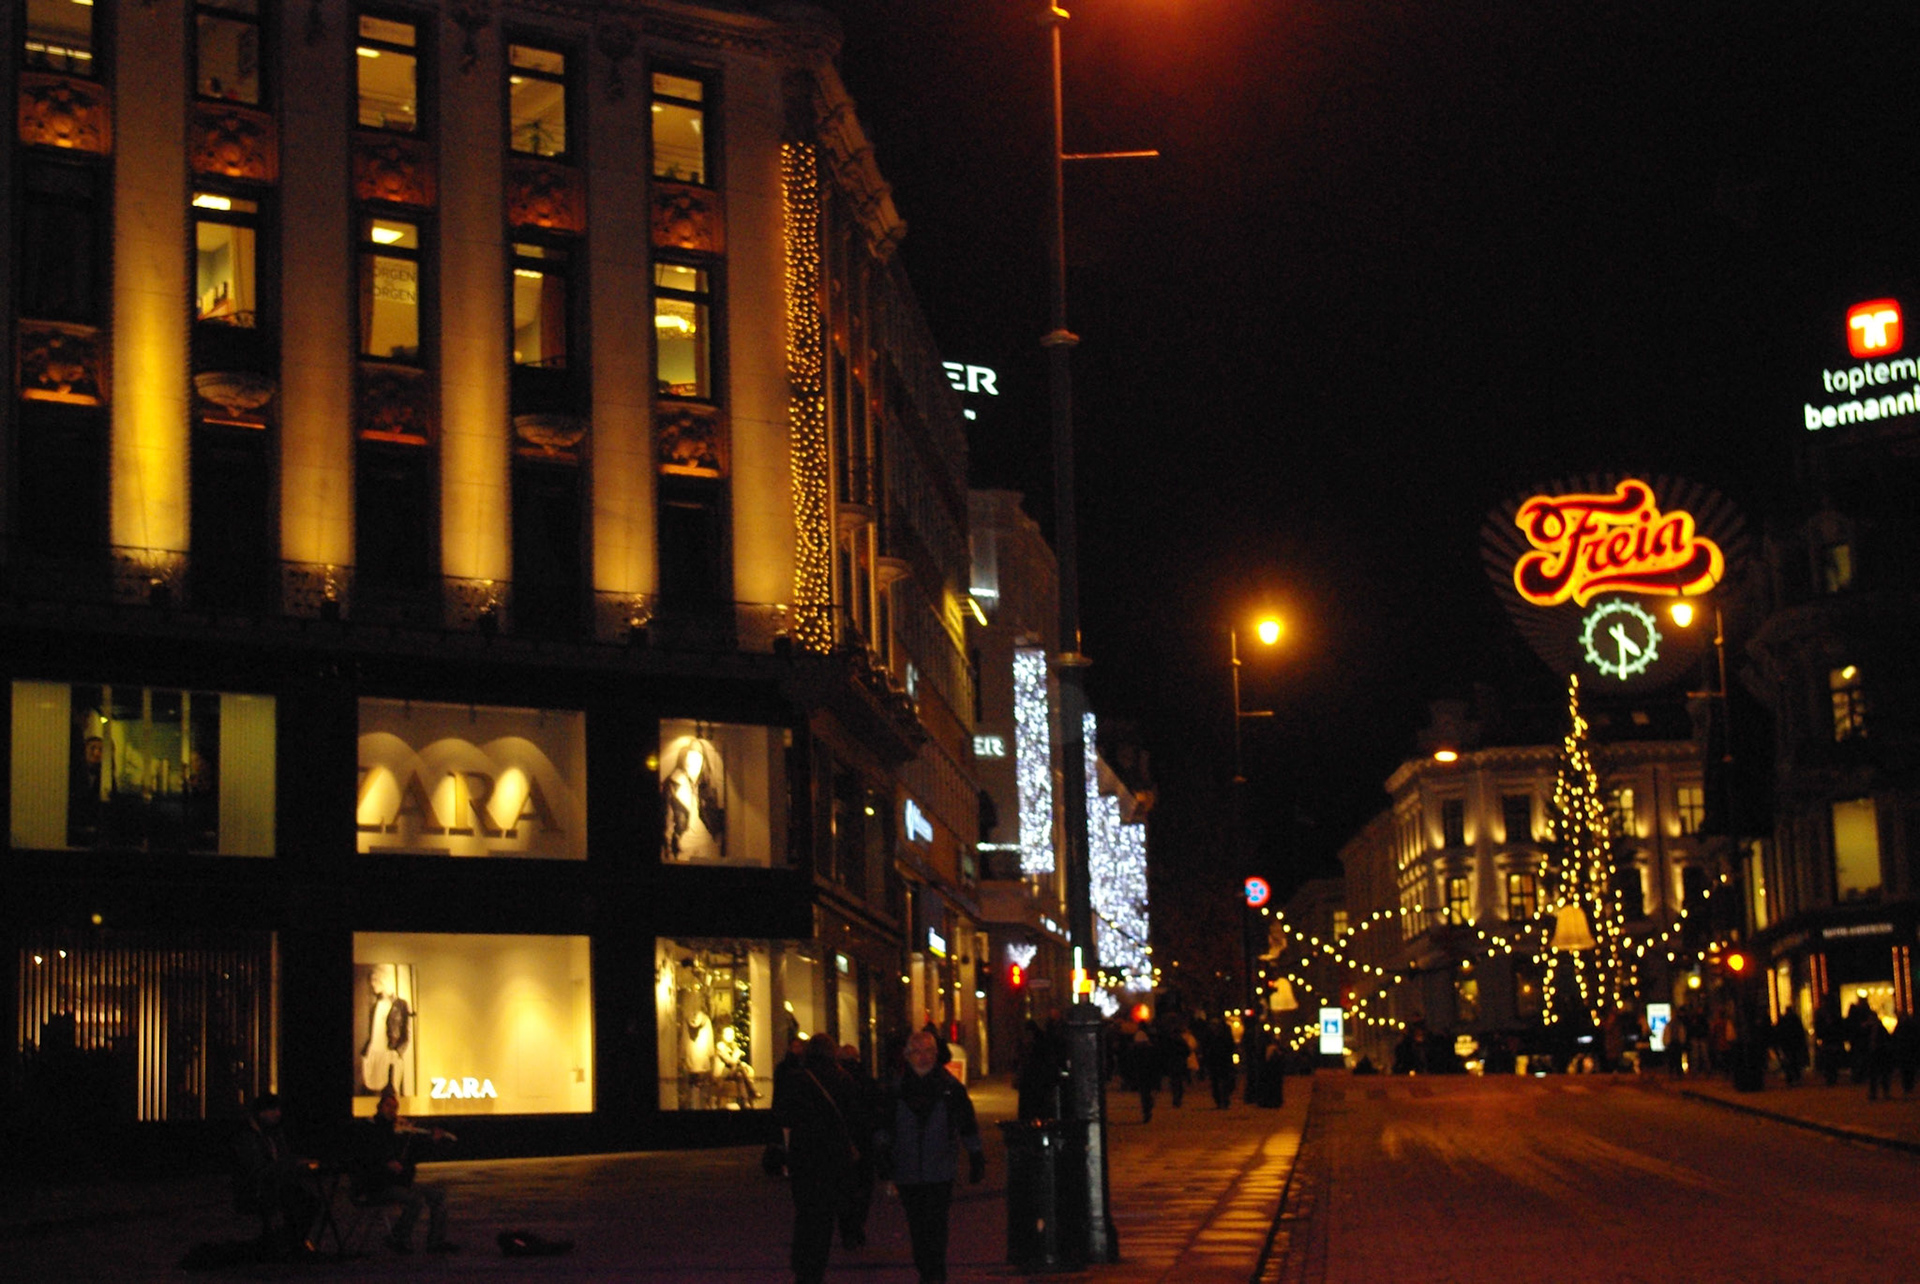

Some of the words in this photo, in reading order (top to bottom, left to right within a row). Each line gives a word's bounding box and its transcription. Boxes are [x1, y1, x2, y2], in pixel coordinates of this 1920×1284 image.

[1515, 480, 1724, 606] Freia
[357, 764, 565, 839] ZARA
[430, 1077, 498, 1099] ZARA
